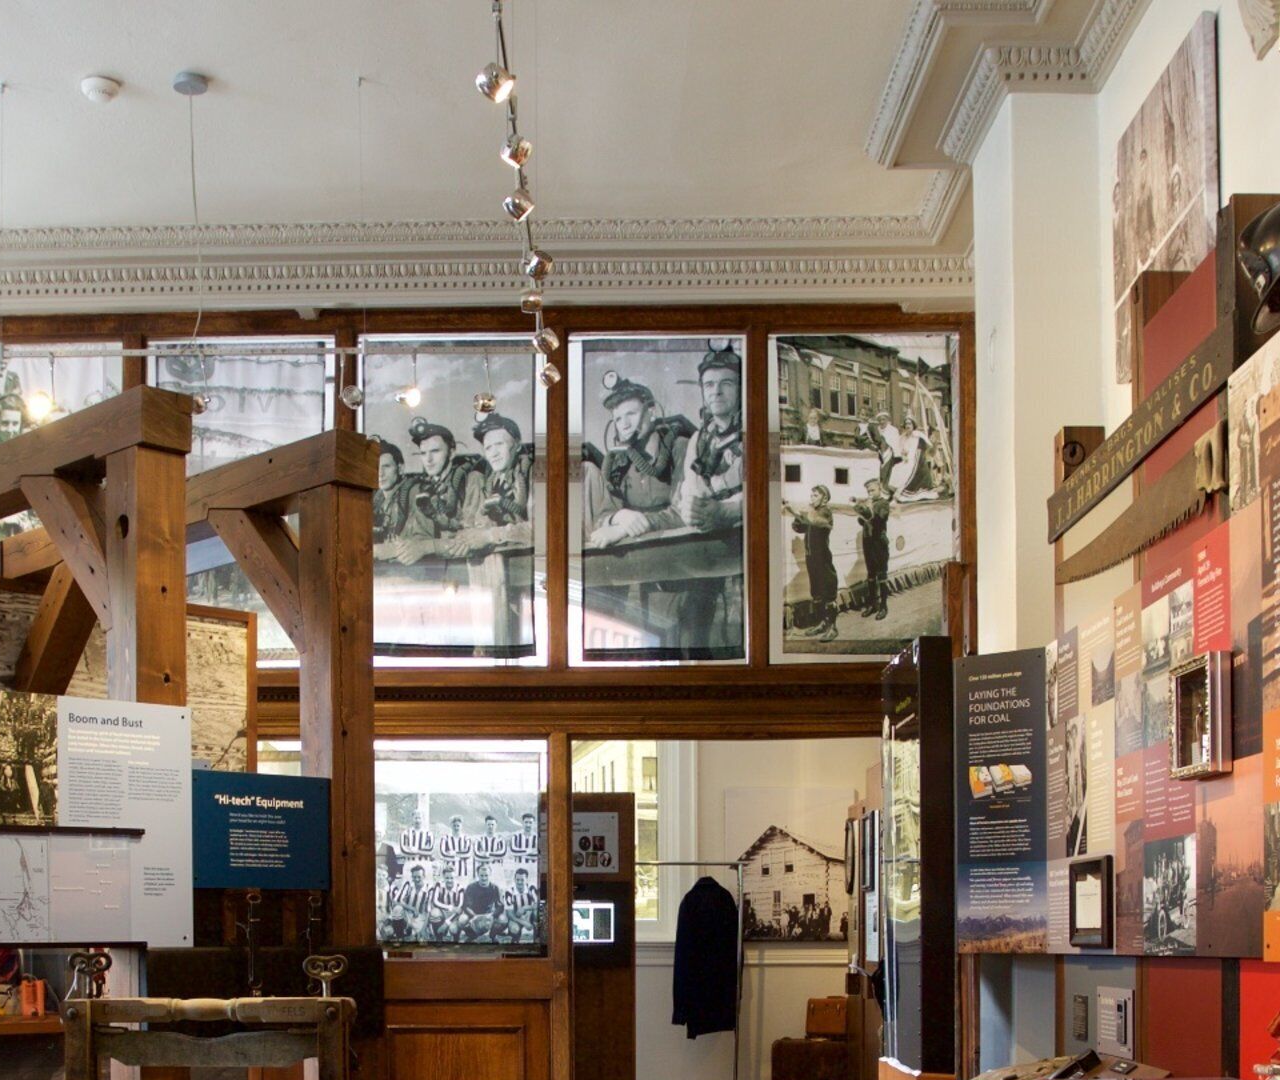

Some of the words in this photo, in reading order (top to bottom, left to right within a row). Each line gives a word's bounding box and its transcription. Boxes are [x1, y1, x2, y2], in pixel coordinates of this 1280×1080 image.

[1146, 354, 1197, 410] VALISES
[1107, 419, 1133, 452] BAGS
[1076, 407, 1165, 513] HARRINGTON
[1171, 393, 1181, 420] &
[968, 688, 1000, 701] LAYING
[1001, 686, 1017, 697] THE
[968, 698, 1031, 713] FOUNDATIONS
[68, 712, 99, 725] Boom
[100, 714, 120, 727] and
[121, 716, 144, 729] Bust
[968, 715, 986, 725] FOR
[987, 713, 1011, 724] COAL
[255, 797, 304, 810] Equipment
